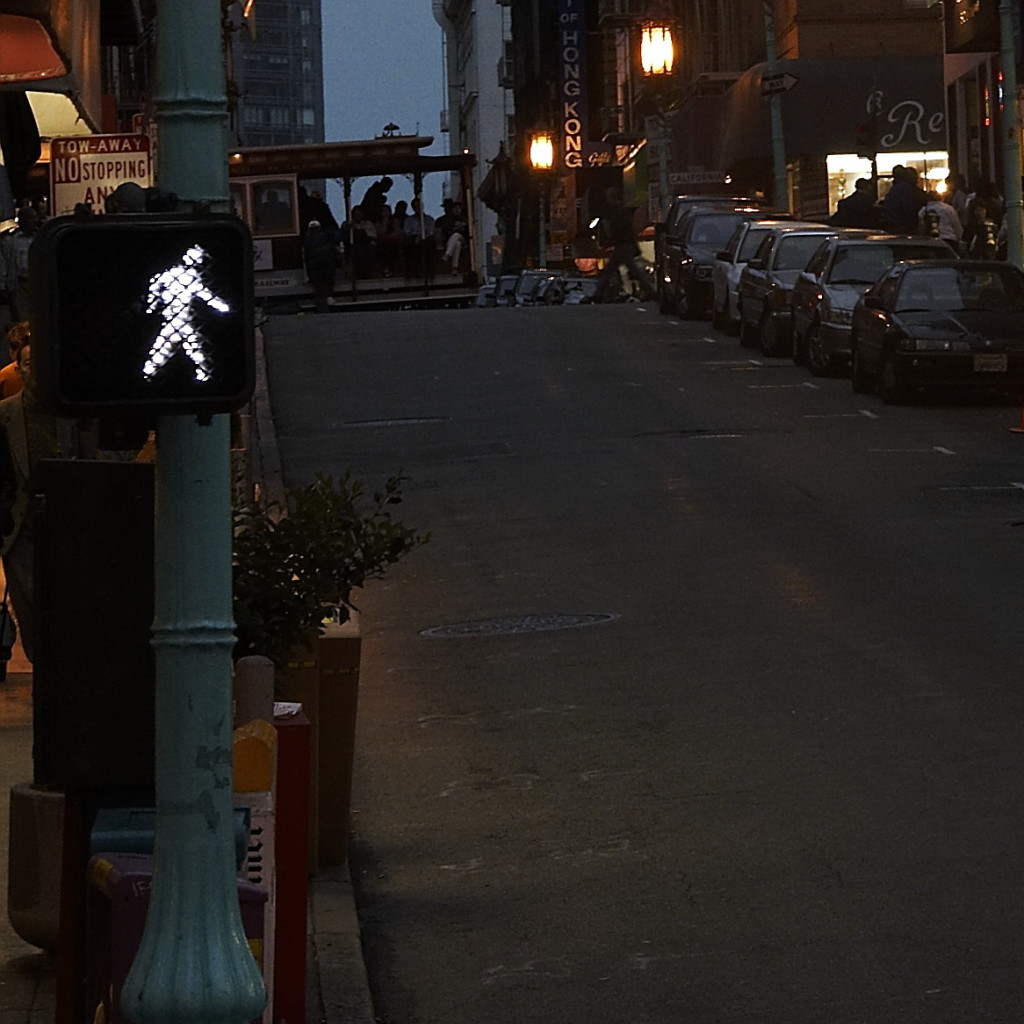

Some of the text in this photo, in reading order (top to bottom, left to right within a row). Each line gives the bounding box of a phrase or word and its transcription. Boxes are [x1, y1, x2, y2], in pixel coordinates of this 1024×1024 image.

[562, 31, 580, 96] HONG
[57, 138, 142, 154] TOW-AWAY
[564, 102, 584, 169] KONG
[55, 156, 146, 182] NO STOPPING
